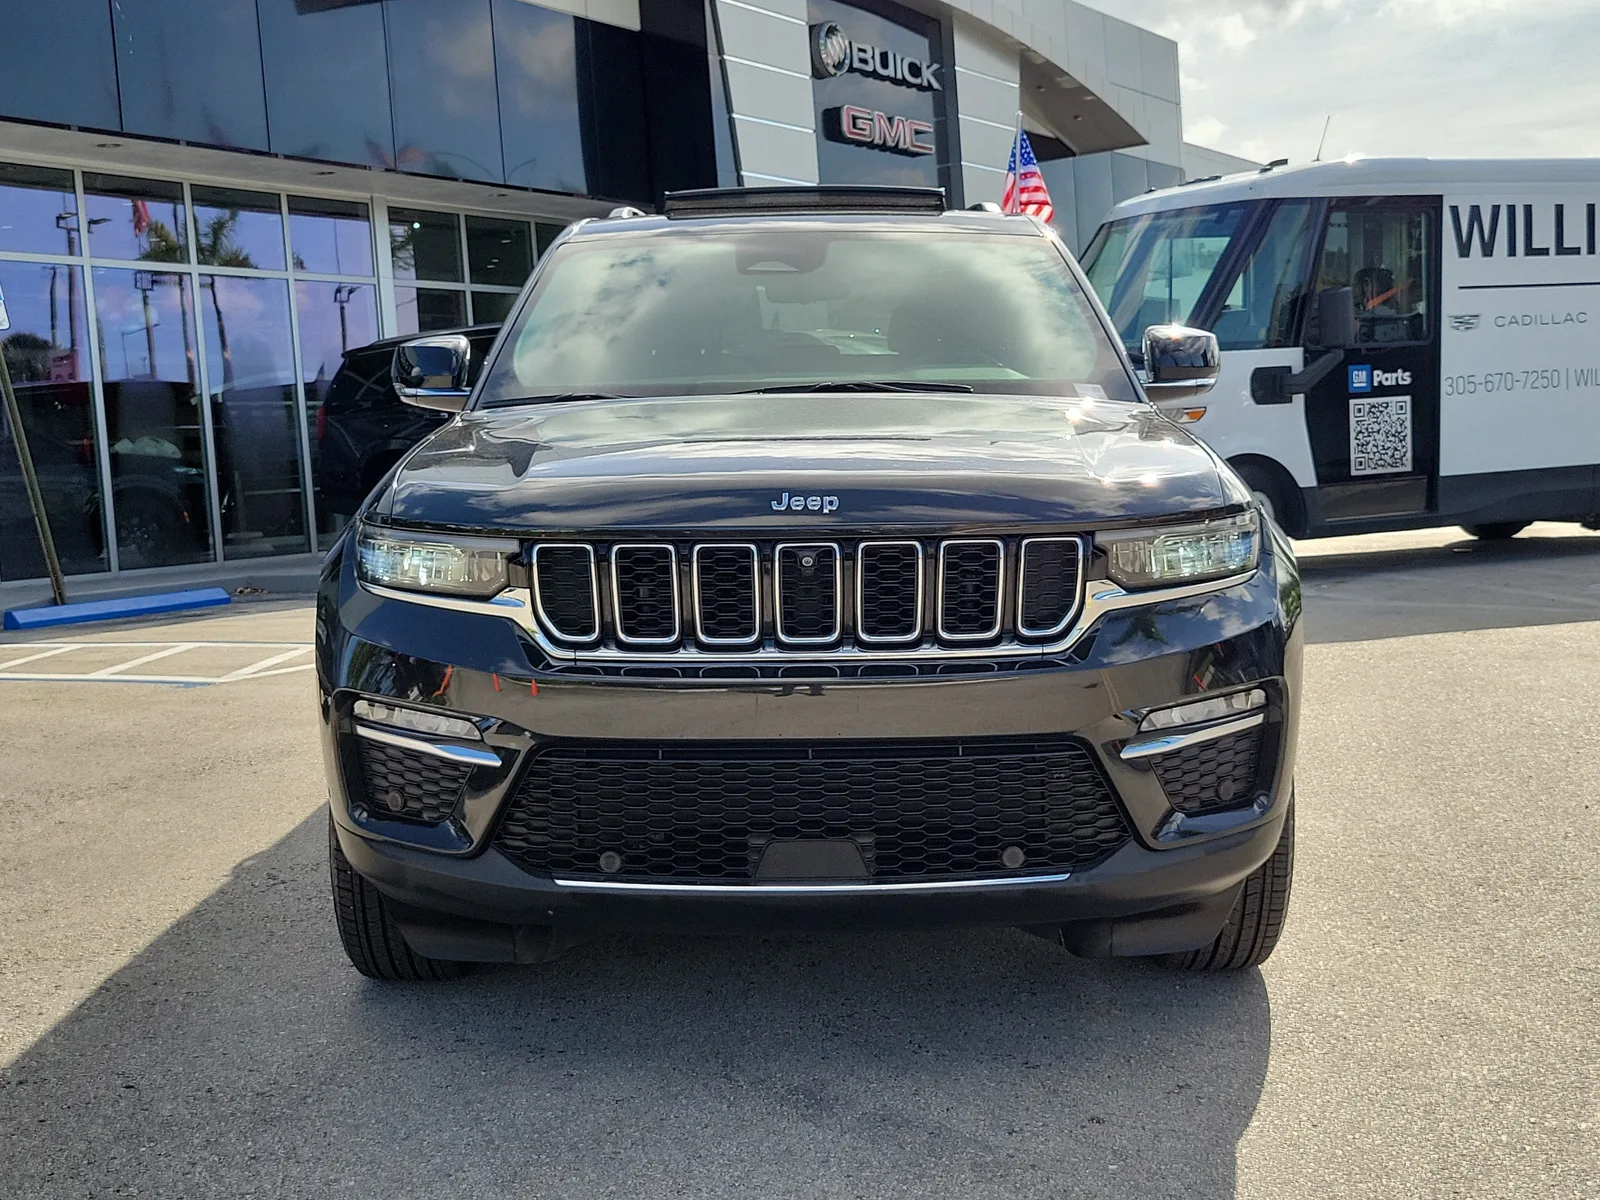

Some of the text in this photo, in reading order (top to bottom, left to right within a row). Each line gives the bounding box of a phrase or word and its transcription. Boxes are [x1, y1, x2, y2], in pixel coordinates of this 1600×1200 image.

[851, 42, 942, 91] BUICK
[842, 104, 935, 154] GMC
[1493, 311, 1588, 328] CADILLAC
[1352, 368, 1412, 387] GM Parts
[1444, 368, 1561, 396] 305-670-7250
[771, 492, 839, 514] Jeep
